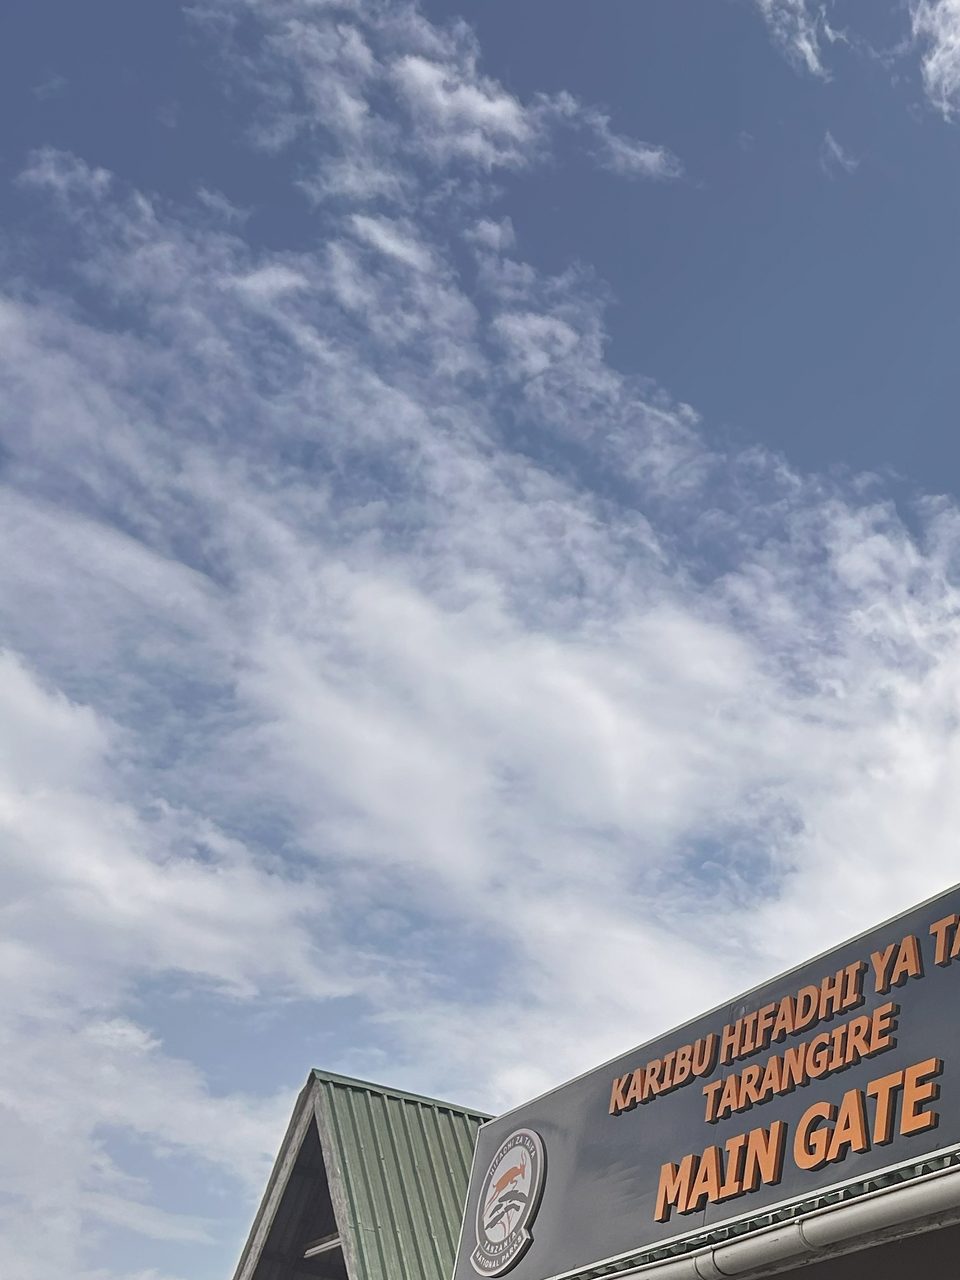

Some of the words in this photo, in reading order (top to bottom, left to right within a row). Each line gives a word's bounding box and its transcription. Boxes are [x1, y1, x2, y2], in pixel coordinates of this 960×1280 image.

[608, 1032, 718, 1116] KARIBU
[719, 960, 865, 1065] HIFADHI
[870, 935, 924, 994] YA
[702, 1002, 899, 1123] TARANGIRE
[489, 1140, 514, 1176] HIFADHI
[515, 1136, 523, 1144] ZA
[523, 1137, 536, 1160] TAIFA
[654, 1121, 787, 1223] MAIN
[794, 1057, 944, 1171] GATE
[475, 1250, 499, 1268] NATIONAL
[501, 1235, 523, 1262] PARKS
[483, 1231, 517, 1254] TANZANIA
